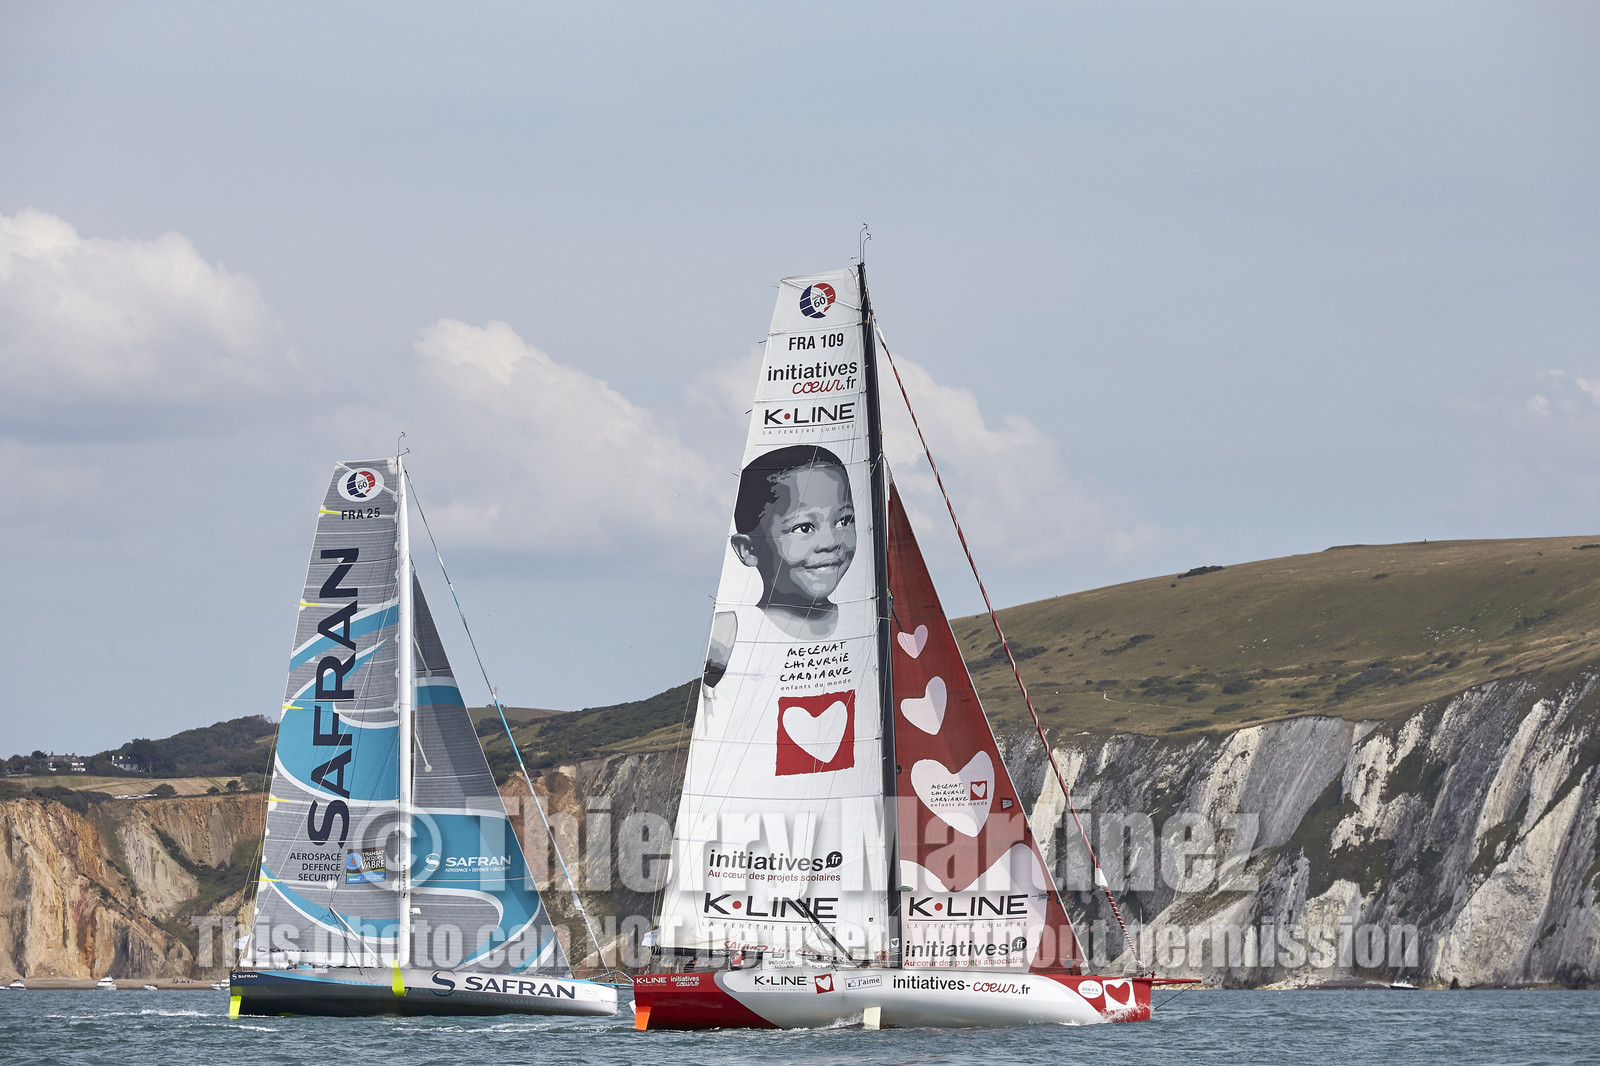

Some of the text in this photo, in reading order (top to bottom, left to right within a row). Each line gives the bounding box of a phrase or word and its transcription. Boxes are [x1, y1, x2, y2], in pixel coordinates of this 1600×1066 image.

[813, 296, 826, 308] 60
[788, 332, 844, 351] FRA 109
[767, 361, 858, 381] initiatives
[341, 507, 380, 520] FRA 25
[308, 548, 359, 849] SAFRAN
[290, 852, 341, 861] AEROSPACE
[445, 855, 511, 867] SAFRAN
[302, 863, 341, 871] DEFENCE
[360, 860, 385, 869] VABRE
[298, 873, 341, 881] SECURITY
[708, 869, 720, 878] Au
[748, 872, 765, 880] des
[767, 873, 798, 882] projets
[801, 873, 841, 881] scolaires
[939, 959, 953, 967] des
[955, 959, 982, 968] projets
[464, 976, 576, 999] SAFRAN
[857, 977, 880, 986] J'aime
